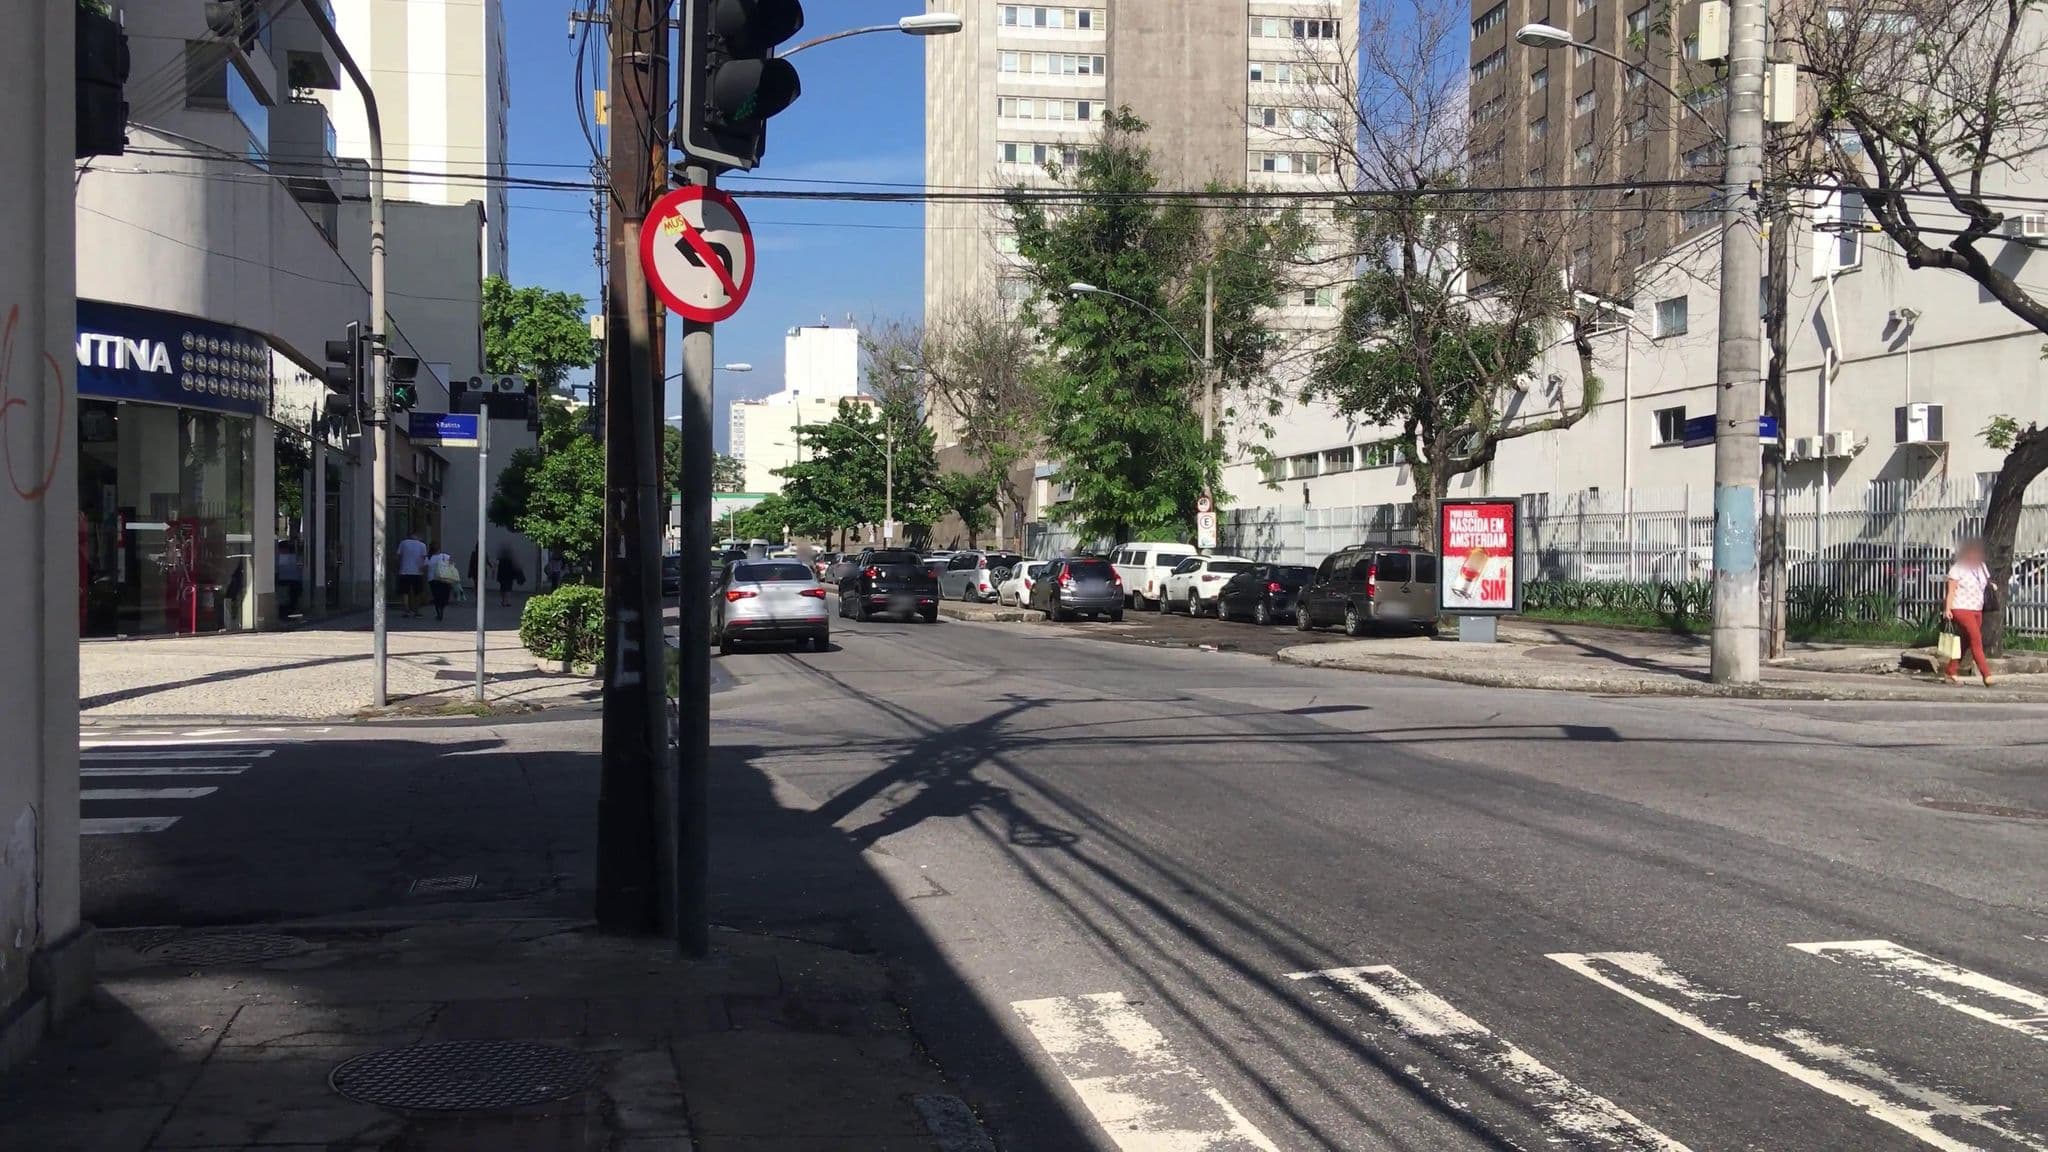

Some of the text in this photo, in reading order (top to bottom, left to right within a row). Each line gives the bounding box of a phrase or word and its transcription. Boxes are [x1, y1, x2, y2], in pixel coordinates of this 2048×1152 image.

[1449, 517, 1504, 533] NASCIDA EM
[1449, 533, 1507, 548] AMSTERDAM
[1481, 580, 1506, 601] SIM
